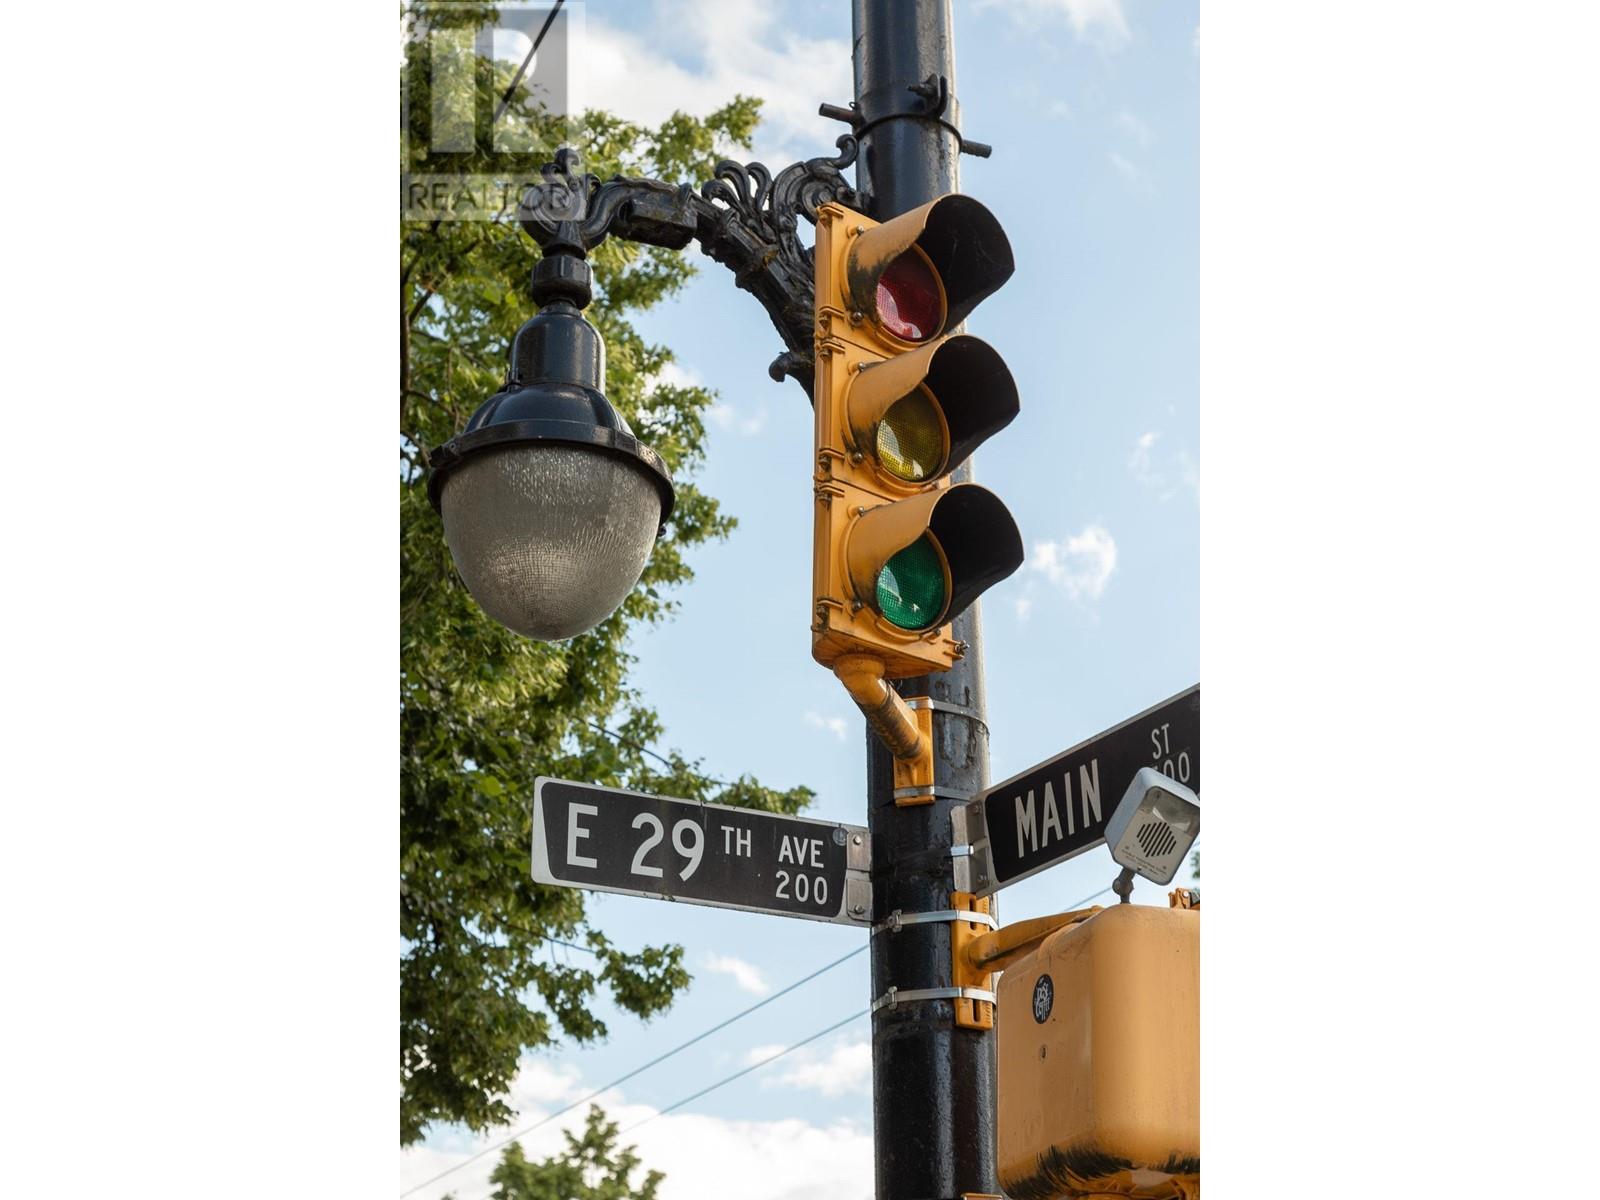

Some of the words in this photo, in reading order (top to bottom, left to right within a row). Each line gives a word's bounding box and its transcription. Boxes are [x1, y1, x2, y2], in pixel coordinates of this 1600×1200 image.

[1015, 758, 1103, 859] MAIN
[1151, 723, 1170, 760] ST
[566, 802, 598, 869] E
[630, 812, 705, 882] 29
[720, 825, 752, 857] TH
[778, 835, 824, 868] AVE
[775, 870, 828, 905] 200
